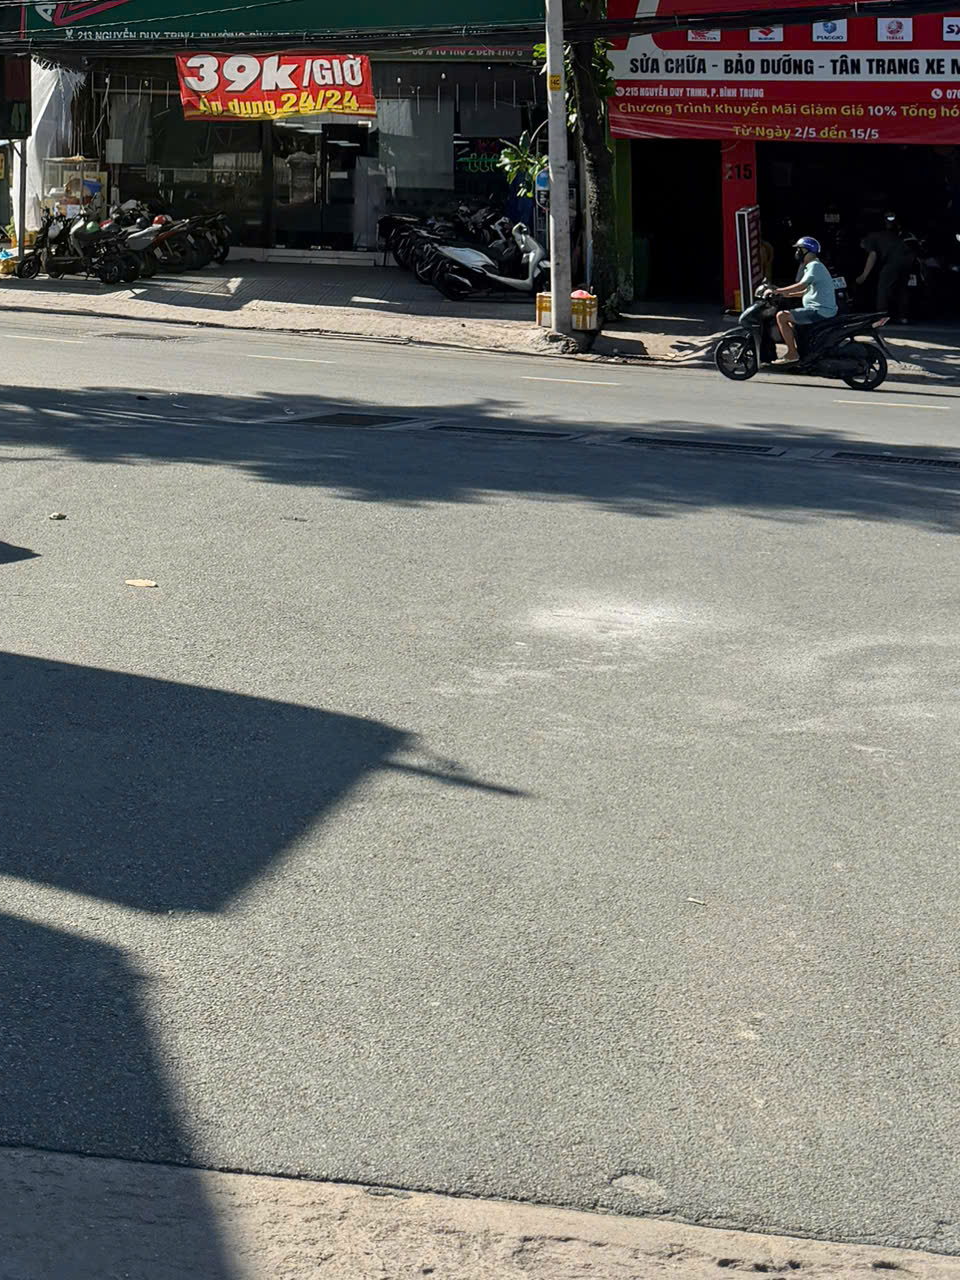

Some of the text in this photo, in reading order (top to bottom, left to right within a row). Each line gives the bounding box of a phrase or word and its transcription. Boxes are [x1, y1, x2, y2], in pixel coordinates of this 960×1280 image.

[630, 53, 660, 74] SỬA
[665, 55, 706, 74] CHỮA
[724, 53, 755, 74] BẢO
[760, 54, 814, 75] DƯỠNG
[830, 54, 861, 75] TÂN
[866, 58, 920, 75] TRANG
[925, 58, 945, 74] XE
[670, 88, 683, 97] DUY
[281, 90, 359, 112] 24/24
[618, 103, 673, 115] Chương
[675, 102, 711, 114] Trình
[772, 104, 796, 115] Mãi
[841, 104, 864, 116] Giá
[868, 106, 897, 117] 10%
[756, 126, 791, 138] Ngày
[795, 127, 816, 138] 2/5
[820, 125, 847, 138] đến
[850, 128, 879, 140] 15/5
